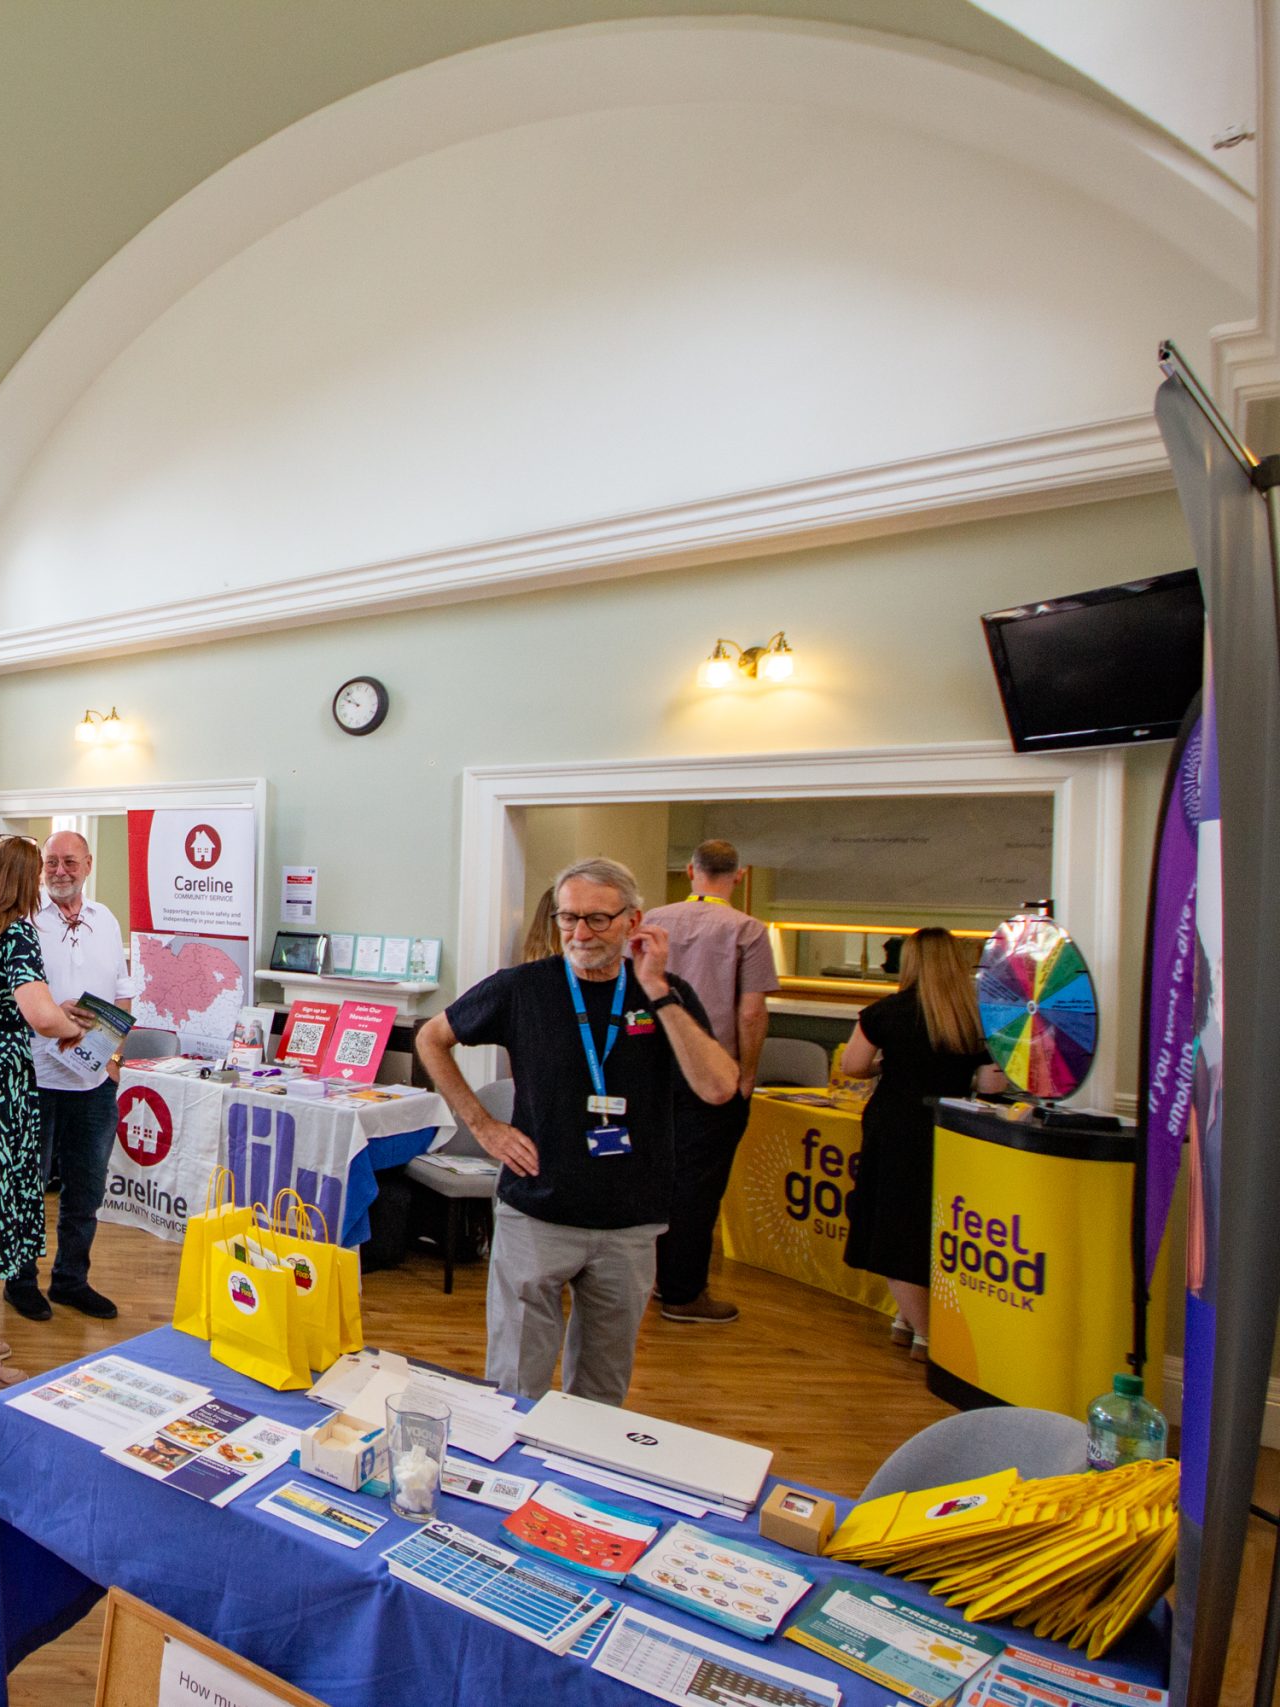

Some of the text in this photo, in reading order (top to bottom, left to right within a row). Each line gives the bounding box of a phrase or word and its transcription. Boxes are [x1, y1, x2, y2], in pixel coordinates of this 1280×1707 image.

[174, 875, 233, 893] Careline
[209, 894, 233, 902] SERVICE
[349, 1013, 382, 1023] Newsletter
[355, 1005, 368, 1013] Join
[105, 1169, 187, 1218] areline
[103, 1199, 187, 1234] MMUNITY SERVICE
[951, 1195, 1029, 1256] feel
[940, 1231, 1046, 1297] good
[959, 1272, 1035, 1312] SUFFOLK
[898, 1606, 978, 1641] FREEDOM
[179, 1671, 211, 1700] How
